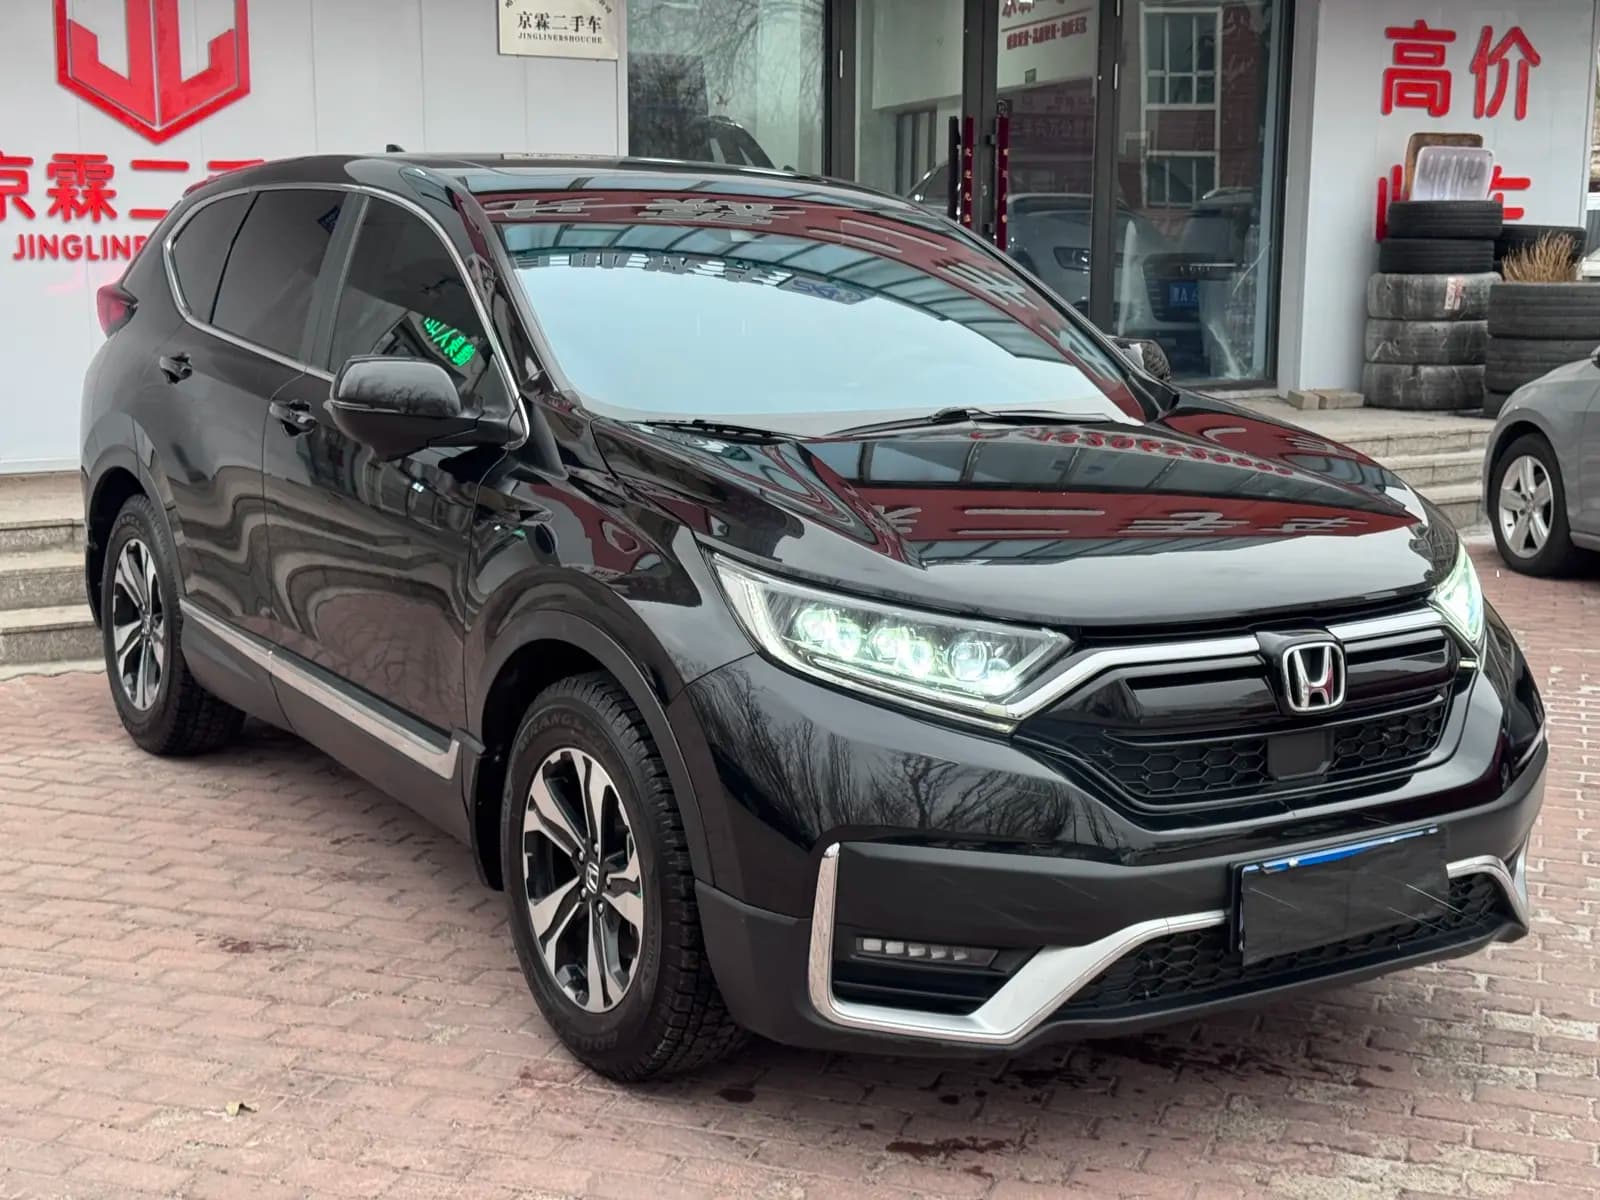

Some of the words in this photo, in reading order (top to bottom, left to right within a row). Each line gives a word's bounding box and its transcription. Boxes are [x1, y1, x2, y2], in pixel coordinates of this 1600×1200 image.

[517, 11, 603, 33] 京霖二手车
[1381, 19, 1541, 121] 高价
